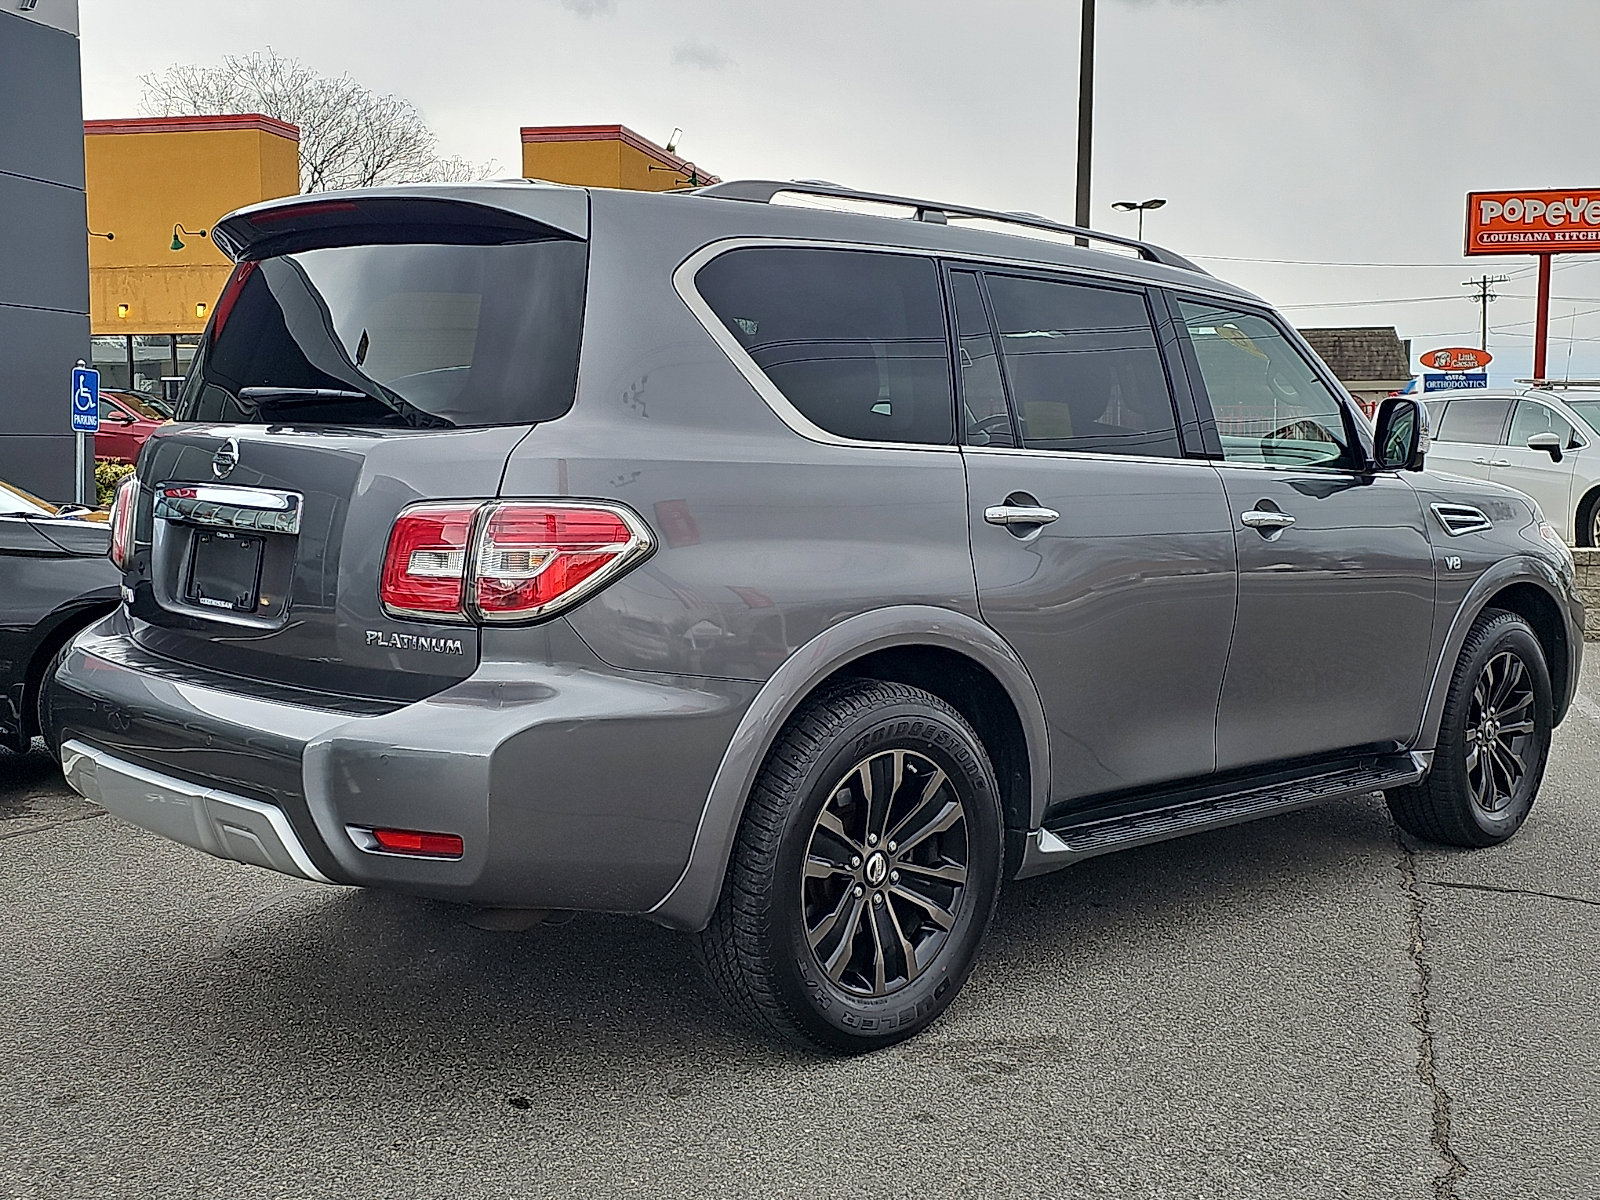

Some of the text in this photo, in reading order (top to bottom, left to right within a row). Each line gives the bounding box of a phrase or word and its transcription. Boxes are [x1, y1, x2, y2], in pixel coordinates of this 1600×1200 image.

[1482, 233, 1551, 243] LOUISIANA
[1451, 360, 1479, 368] Caesars
[1425, 380, 1486, 389] ORTHODONTICS
[74, 414, 97, 426] PARKING
[1444, 556, 1461, 570] V8
[365, 630, 463, 655] PLATINUM
